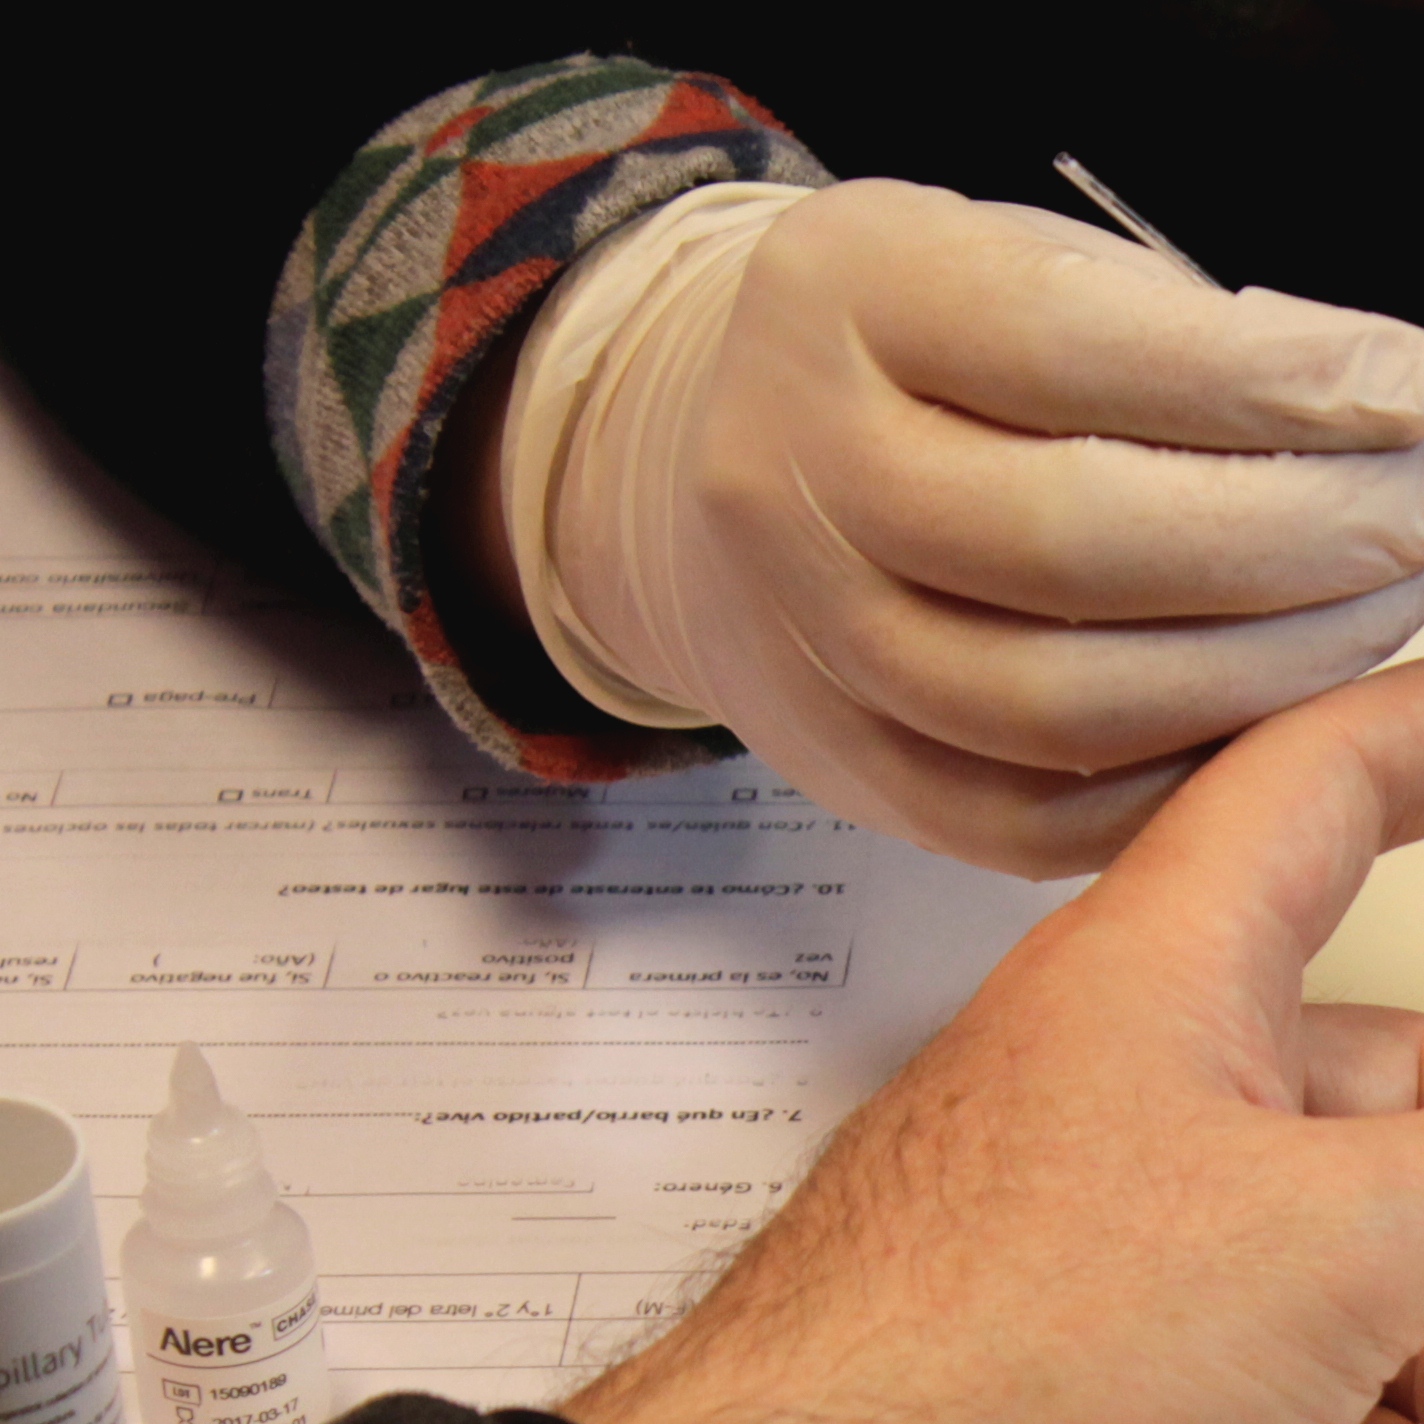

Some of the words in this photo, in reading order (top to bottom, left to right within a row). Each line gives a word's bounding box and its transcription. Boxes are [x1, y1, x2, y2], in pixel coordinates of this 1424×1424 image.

[252, 788, 312, 801] Trans
[116, 821, 145, 834] las
[154, 821, 216, 833] todas
[278, 883, 367, 897] testeo?
[375, 883, 404, 897] de
[410, 882, 470, 897] lugar
[478, 884, 527, 896] este
[534, 884, 563, 897] de
[570, 884, 683, 897] enteraste
[690, 884, 714, 897] te
[482, 952, 575, 966] positivo
[130, 970, 232, 985] negativo
[240, 973, 277, 985] fue
[397, 972, 491, 985] reactivo
[499, 971, 536, 985] fue
[629, 969, 722, 984] primera
[729, 971, 748, 985] la
[757, 971, 782, 983] es
[492, 1108, 669, 1124] barrio/partido
[677, 1108, 723, 1126] qué
[389, 1303, 422, 1320] del
[430, 1303, 477, 1320] letra
[160, 1327, 252, 1357] Alere
